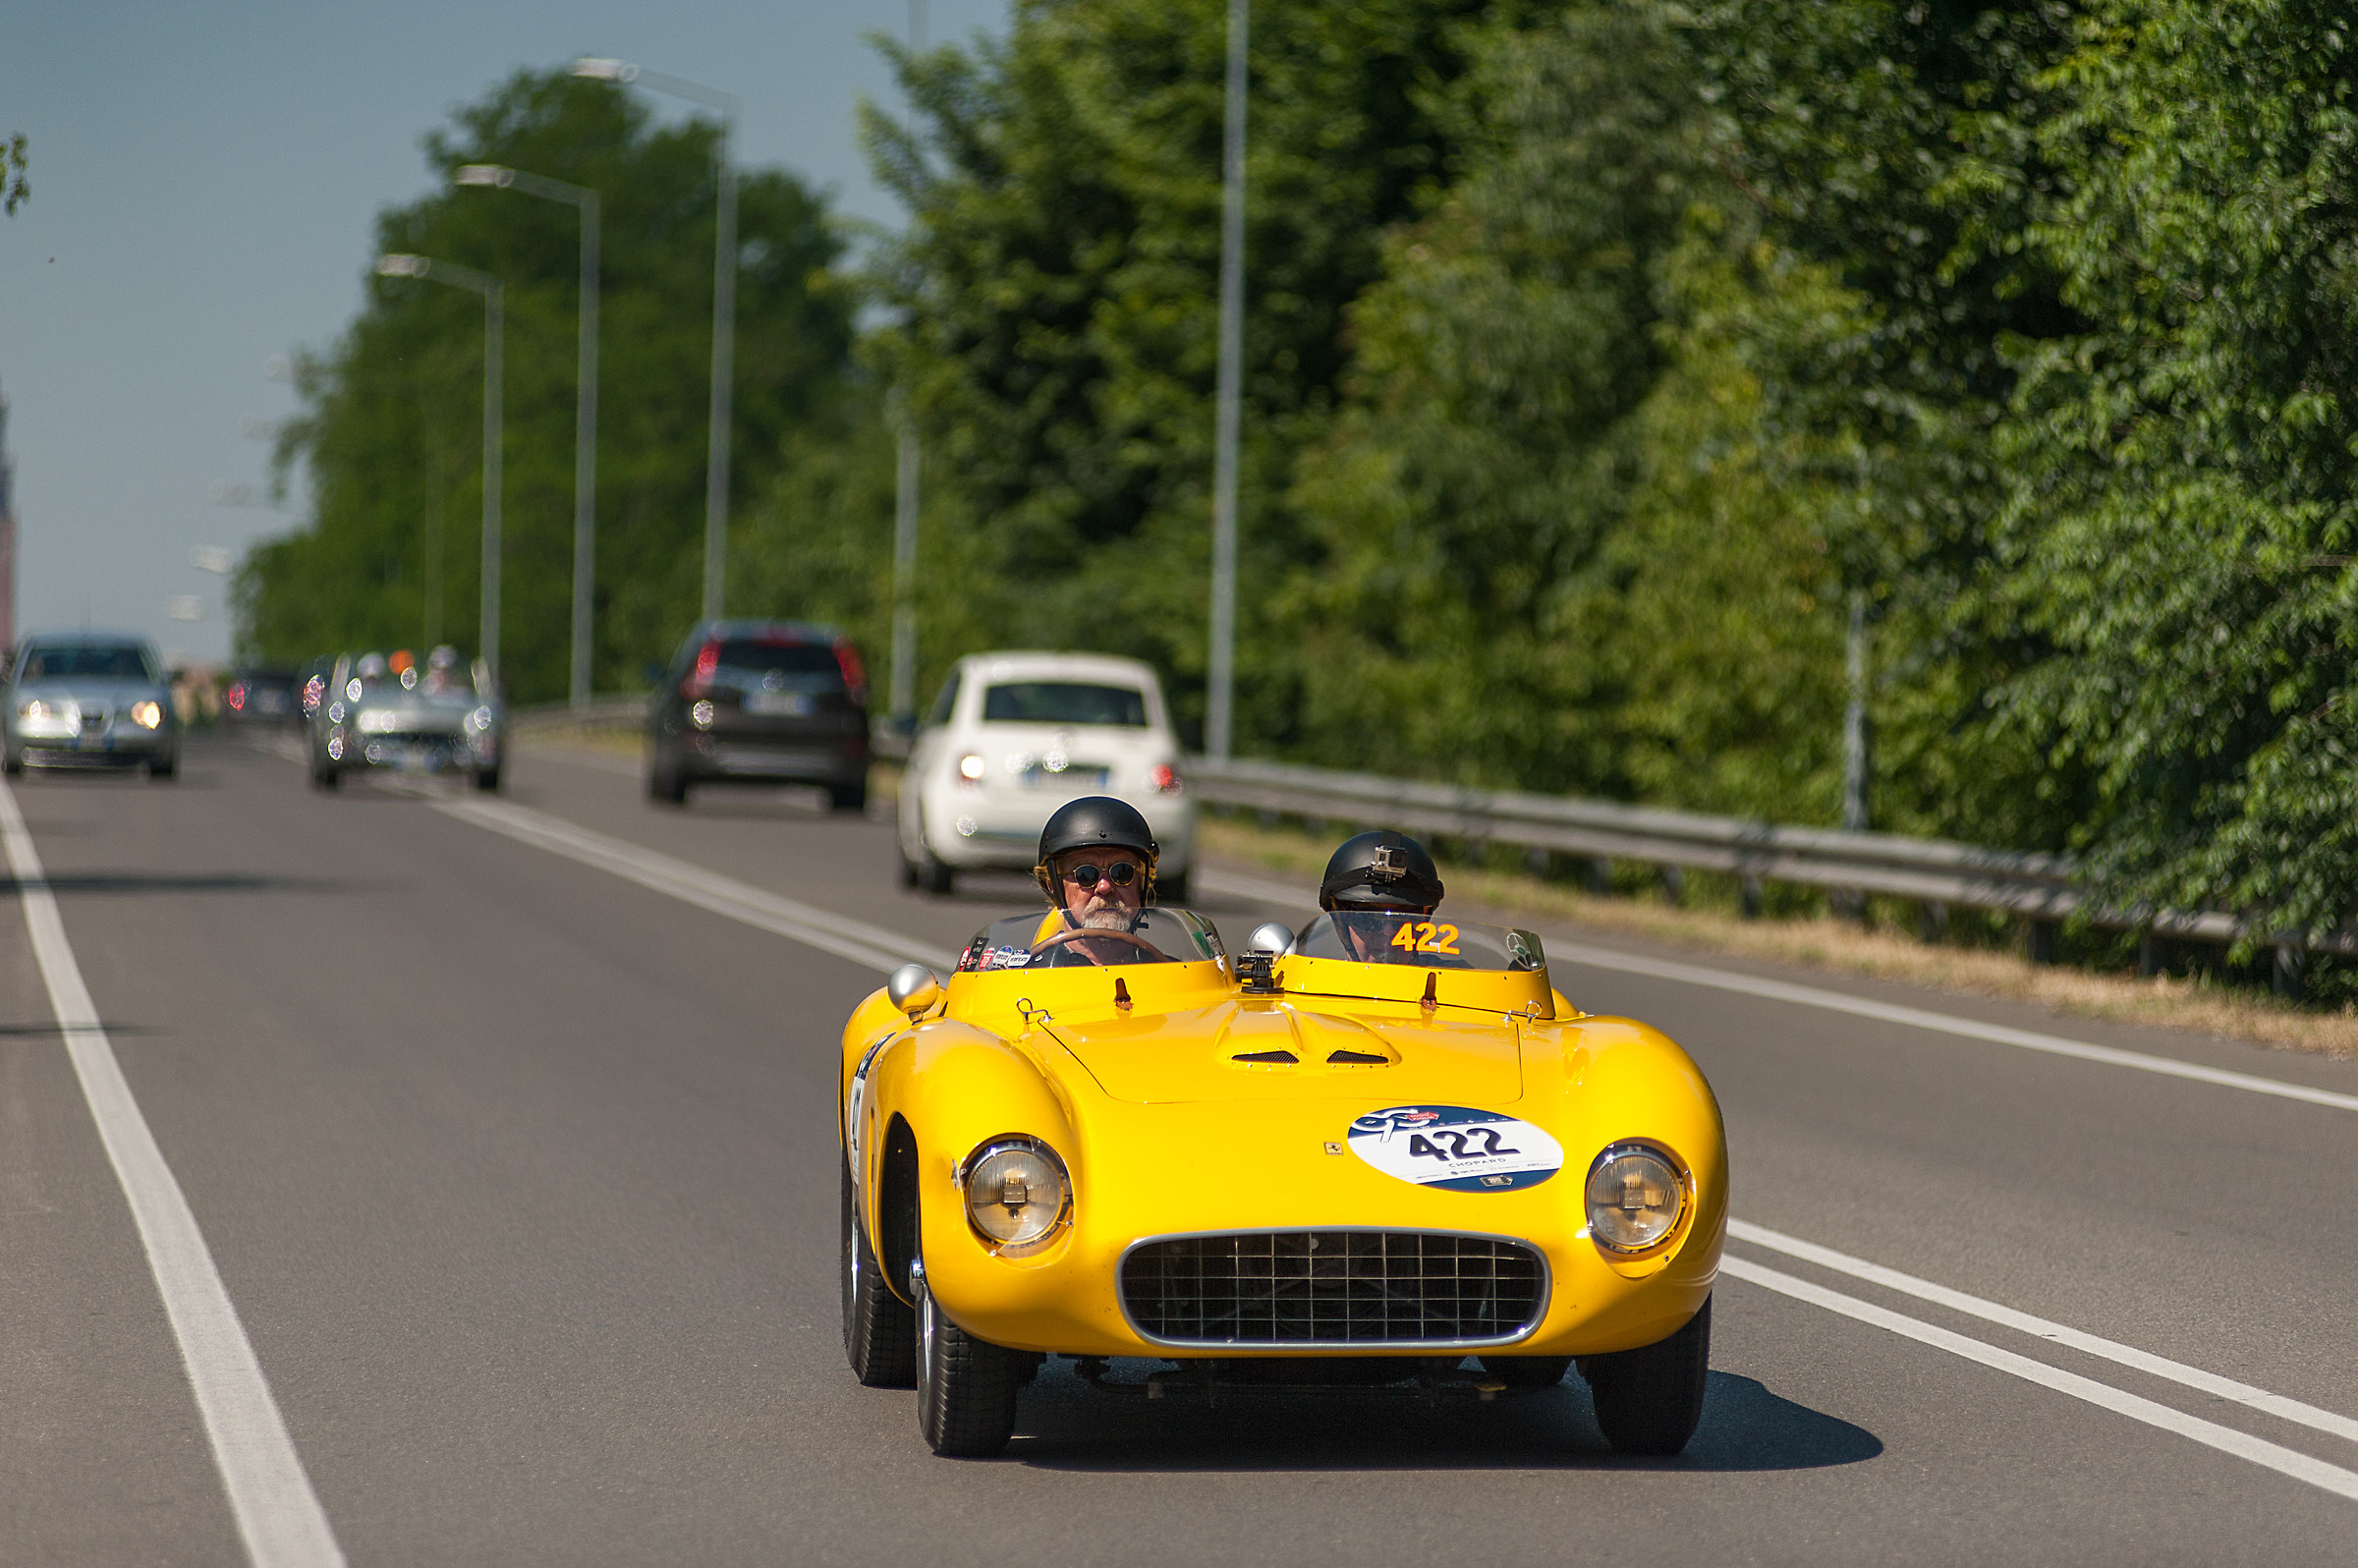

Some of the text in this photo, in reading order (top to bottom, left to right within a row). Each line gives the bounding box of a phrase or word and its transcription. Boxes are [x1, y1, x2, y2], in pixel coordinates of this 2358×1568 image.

[1391, 922, 1461, 955] 422
[1409, 1128, 1521, 1161] 422
[1448, 1157, 1507, 1168] CHOPARD
